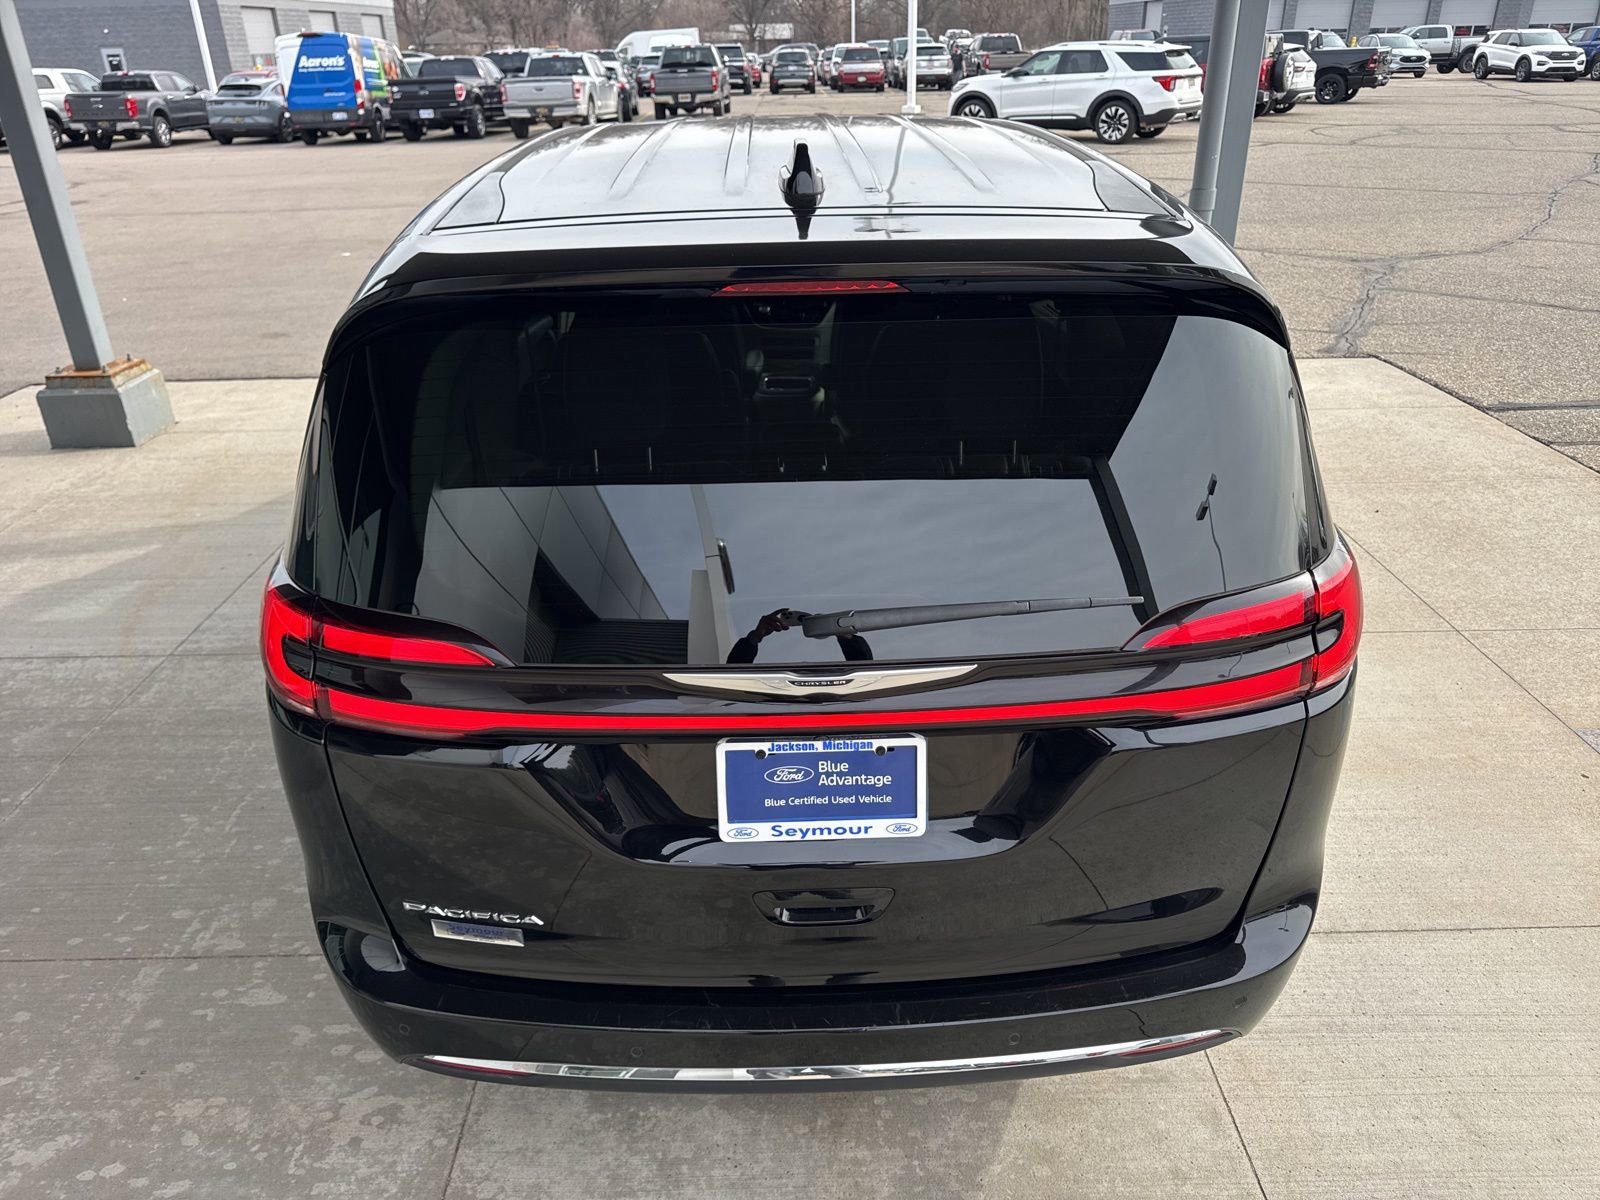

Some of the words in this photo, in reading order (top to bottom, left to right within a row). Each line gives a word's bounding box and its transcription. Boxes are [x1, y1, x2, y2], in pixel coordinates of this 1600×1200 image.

[298, 55, 345, 67] Aaron's
[767, 741, 819, 753] Jackson,
[822, 740, 873, 752] Michigan
[818, 761, 849, 773] Blue
[772, 767, 806, 782] Ford
[818, 773, 892, 787] Advantage
[764, 798, 786, 807] Blue
[788, 796, 829, 806] Certified
[831, 795, 856, 804] Used
[858, 794, 892, 803] Vehicle
[730, 828, 755, 839] Ford
[771, 824, 873, 840] Seymour
[889, 823, 914, 834] Ford
[402, 900, 545, 926] PACIFICA
